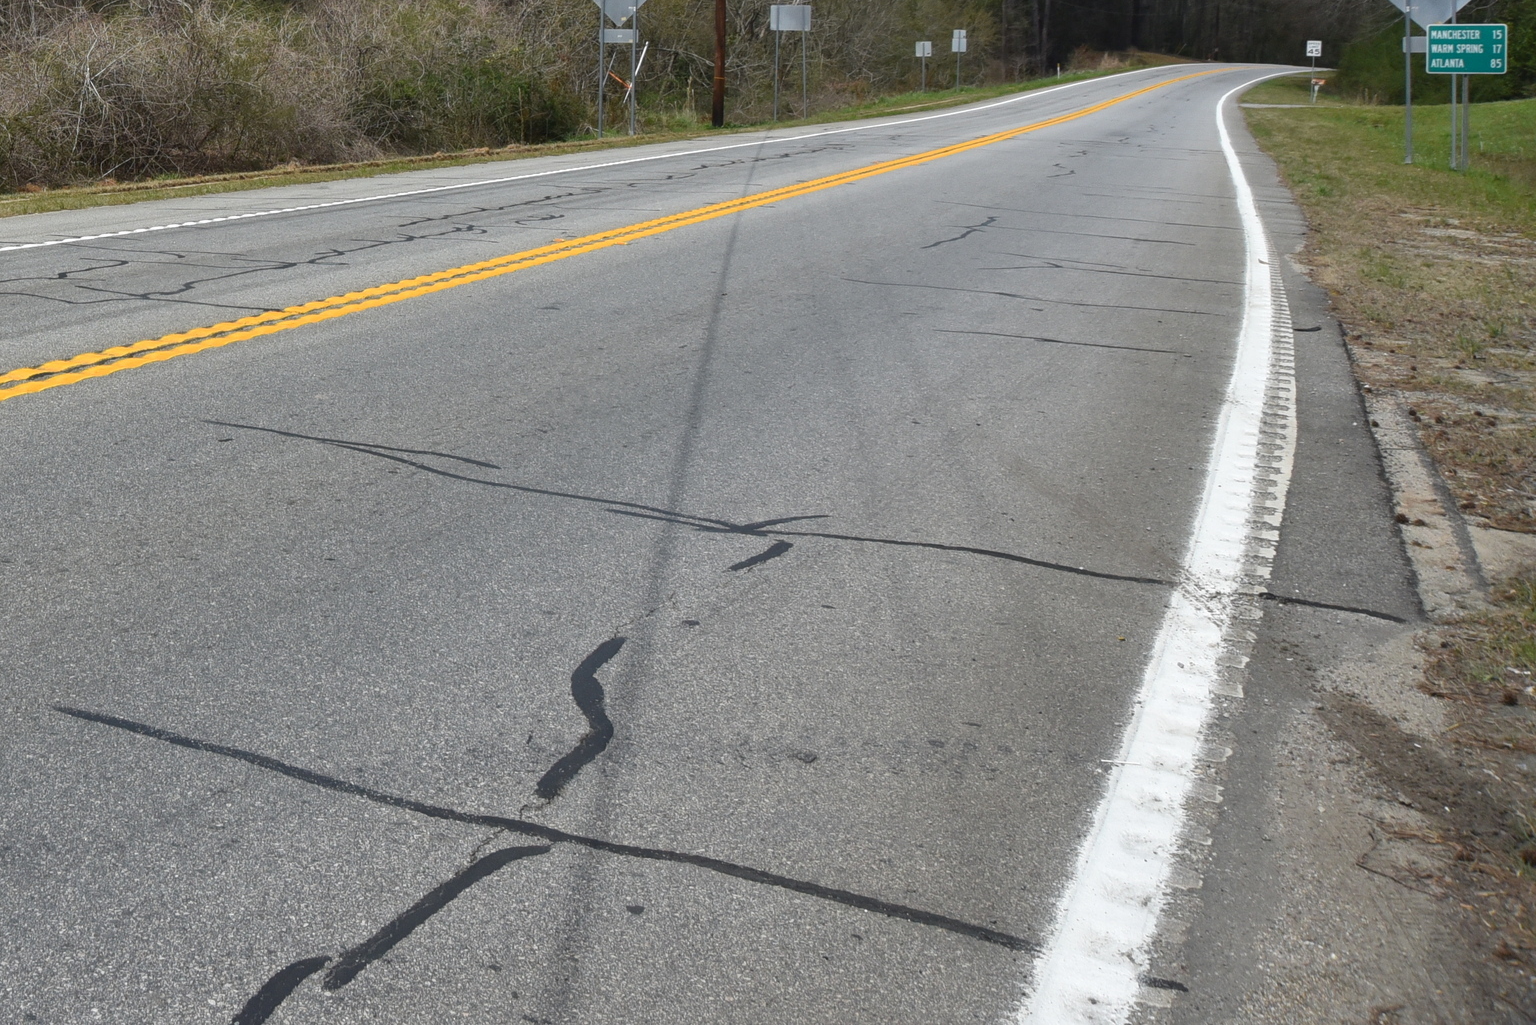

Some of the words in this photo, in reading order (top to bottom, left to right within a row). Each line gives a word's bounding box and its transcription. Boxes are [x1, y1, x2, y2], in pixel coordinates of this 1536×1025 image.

[1431, 30, 1480, 39] MANCHESTER
[1492, 30, 1502, 39] 15
[1431, 44, 1454, 53] WARM
[1456, 44, 1483, 53] SPRING
[1492, 44, 1502, 53] 17
[1431, 59, 1464, 68] ATLANTA
[1490, 59, 1502, 68] 85
